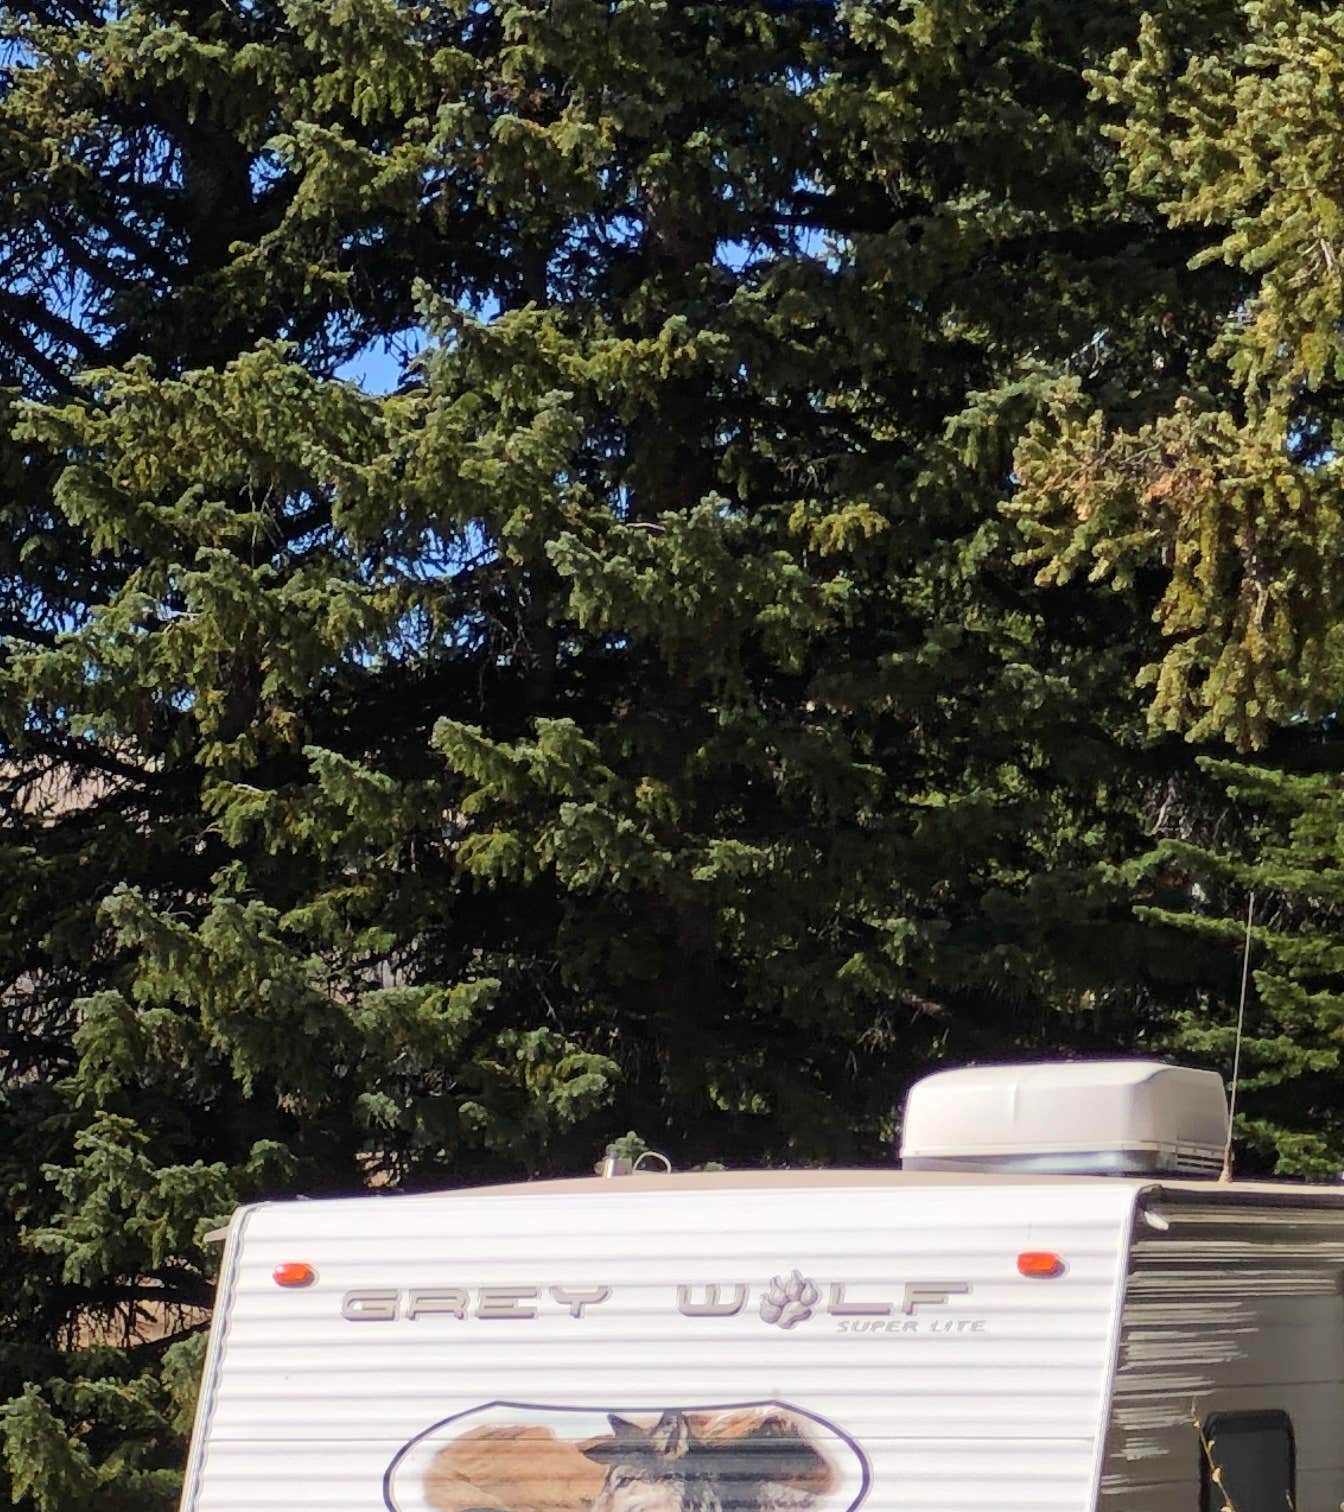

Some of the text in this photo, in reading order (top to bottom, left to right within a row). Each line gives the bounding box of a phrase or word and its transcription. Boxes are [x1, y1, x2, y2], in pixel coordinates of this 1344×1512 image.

[342, 1285, 612, 1321] GREY
[837, 1320, 987, 1333] SUPER LITE
